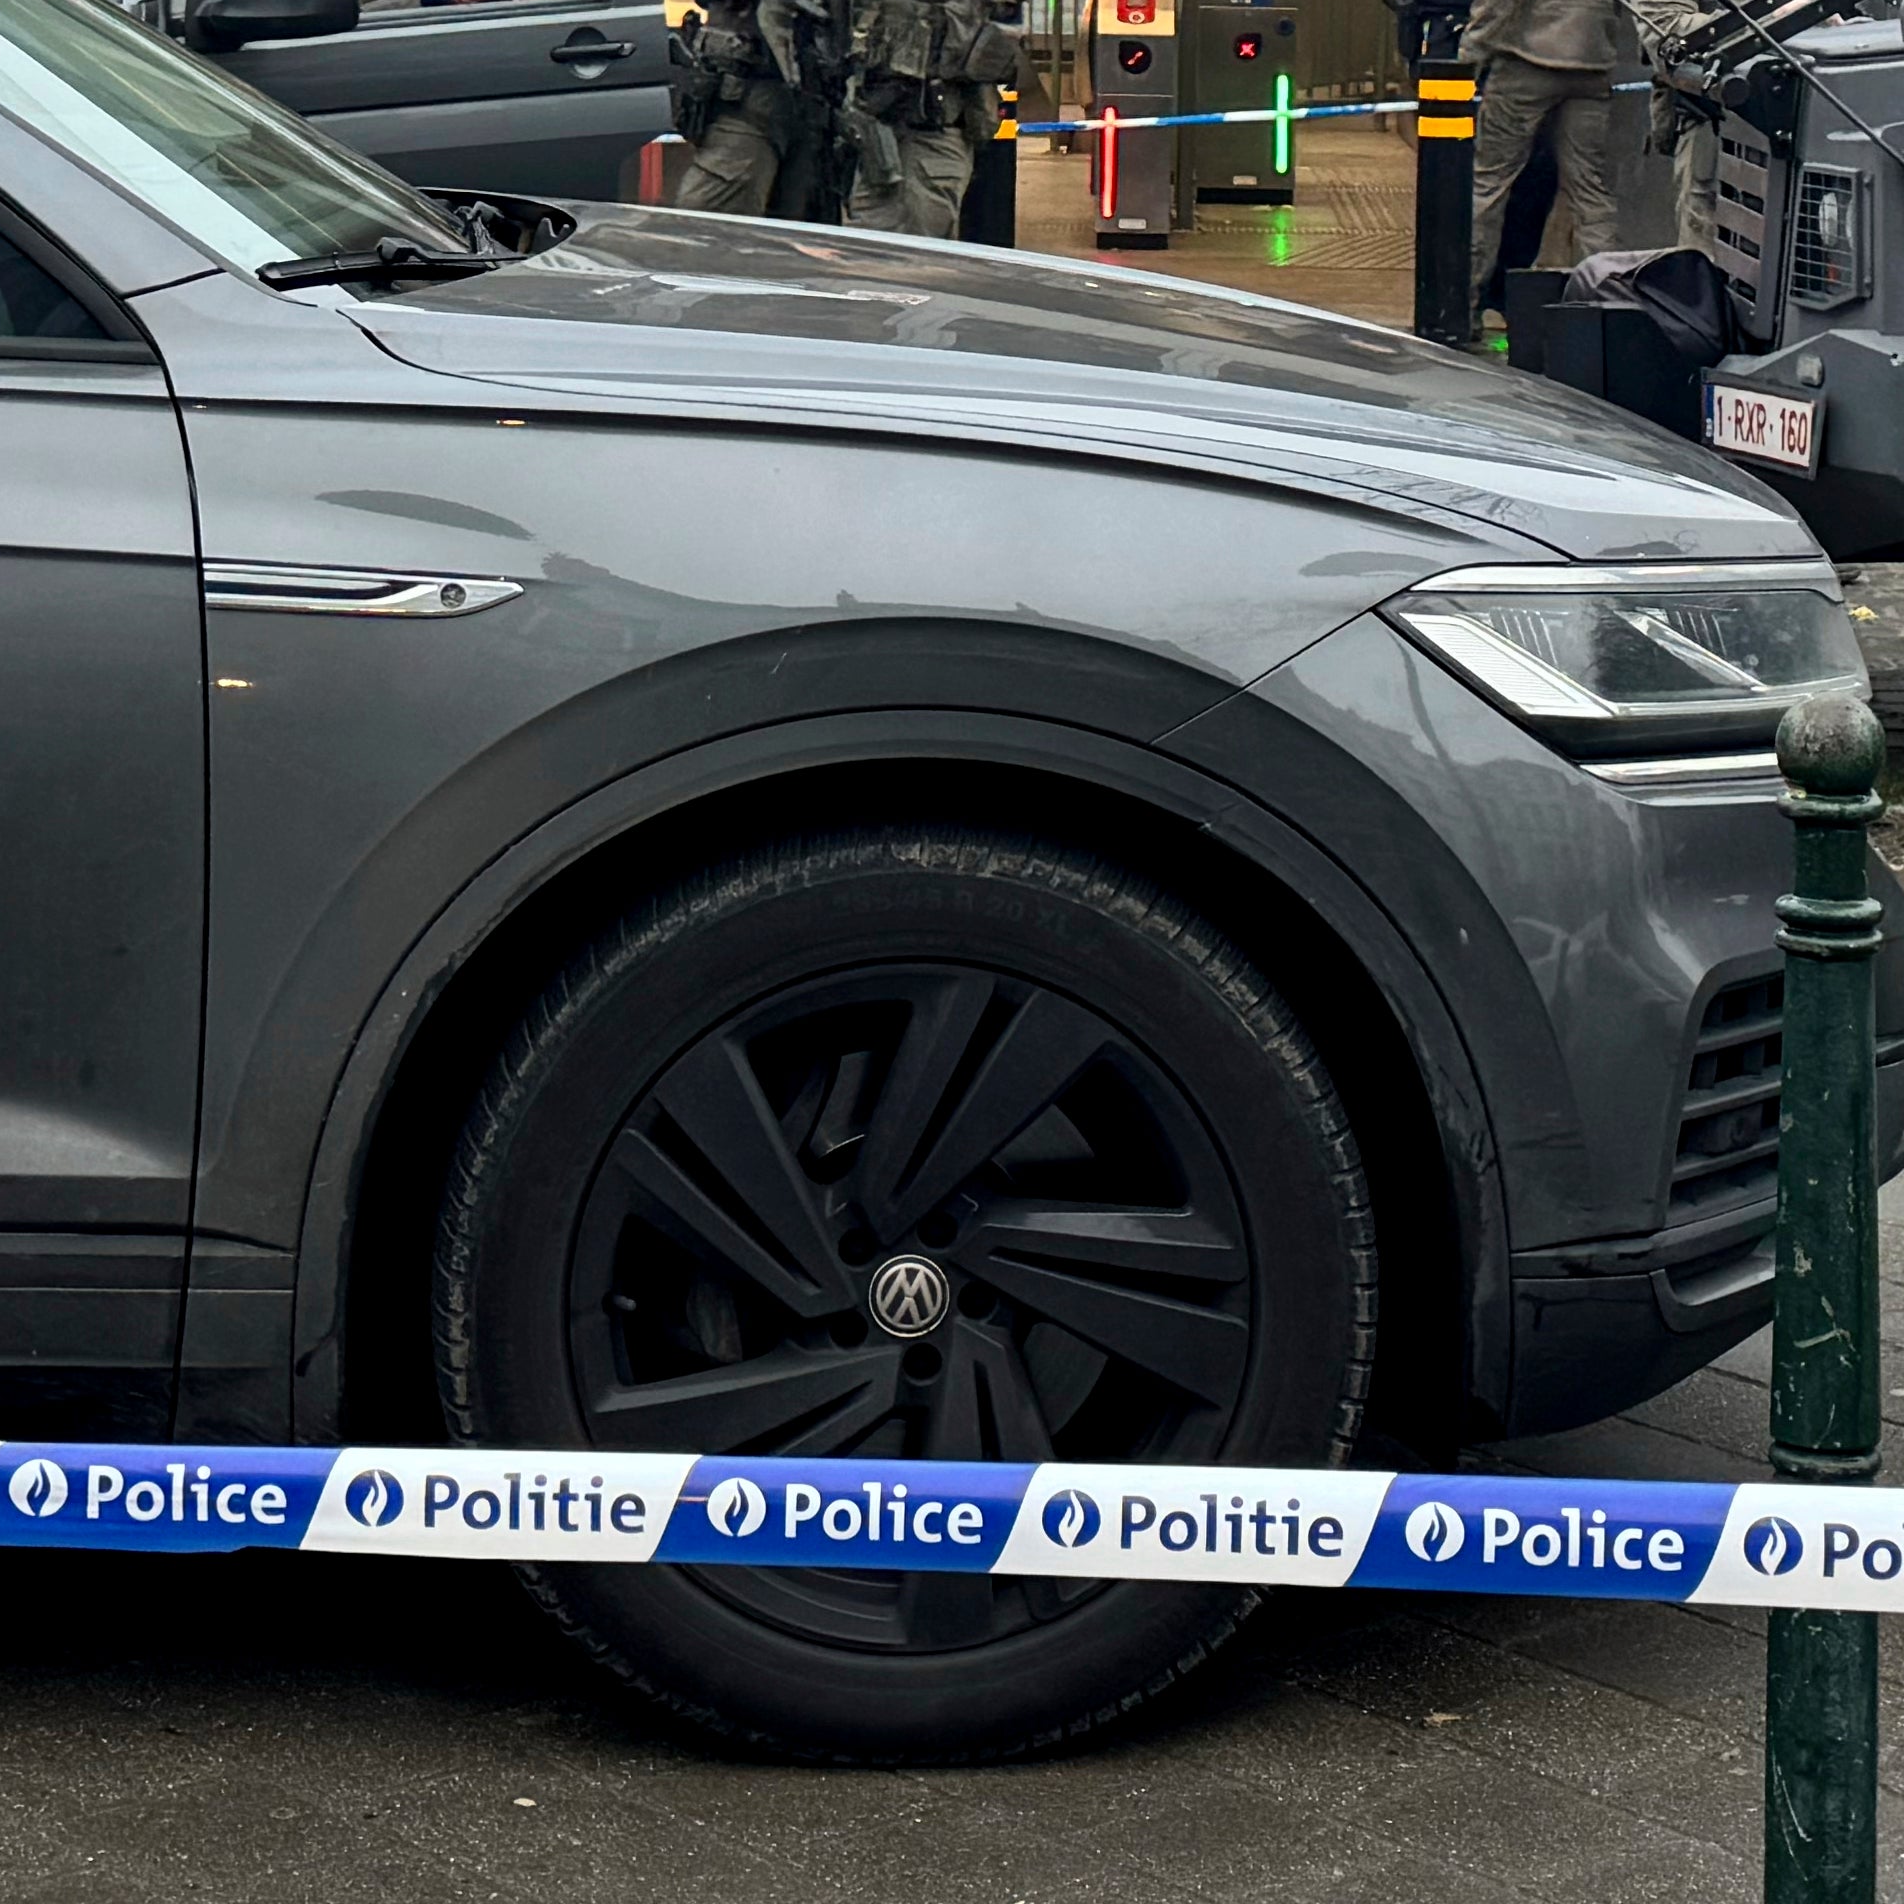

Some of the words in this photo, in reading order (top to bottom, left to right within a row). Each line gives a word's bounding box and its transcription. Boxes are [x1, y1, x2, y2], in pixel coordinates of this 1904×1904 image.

[85, 1462, 287, 1525] Police
[423, 1472, 647, 1535] Politie
[784, 1480, 984, 1545] Police
[1119, 1493, 1345, 1559] Politie
[1482, 1506, 1684, 1572] Police
